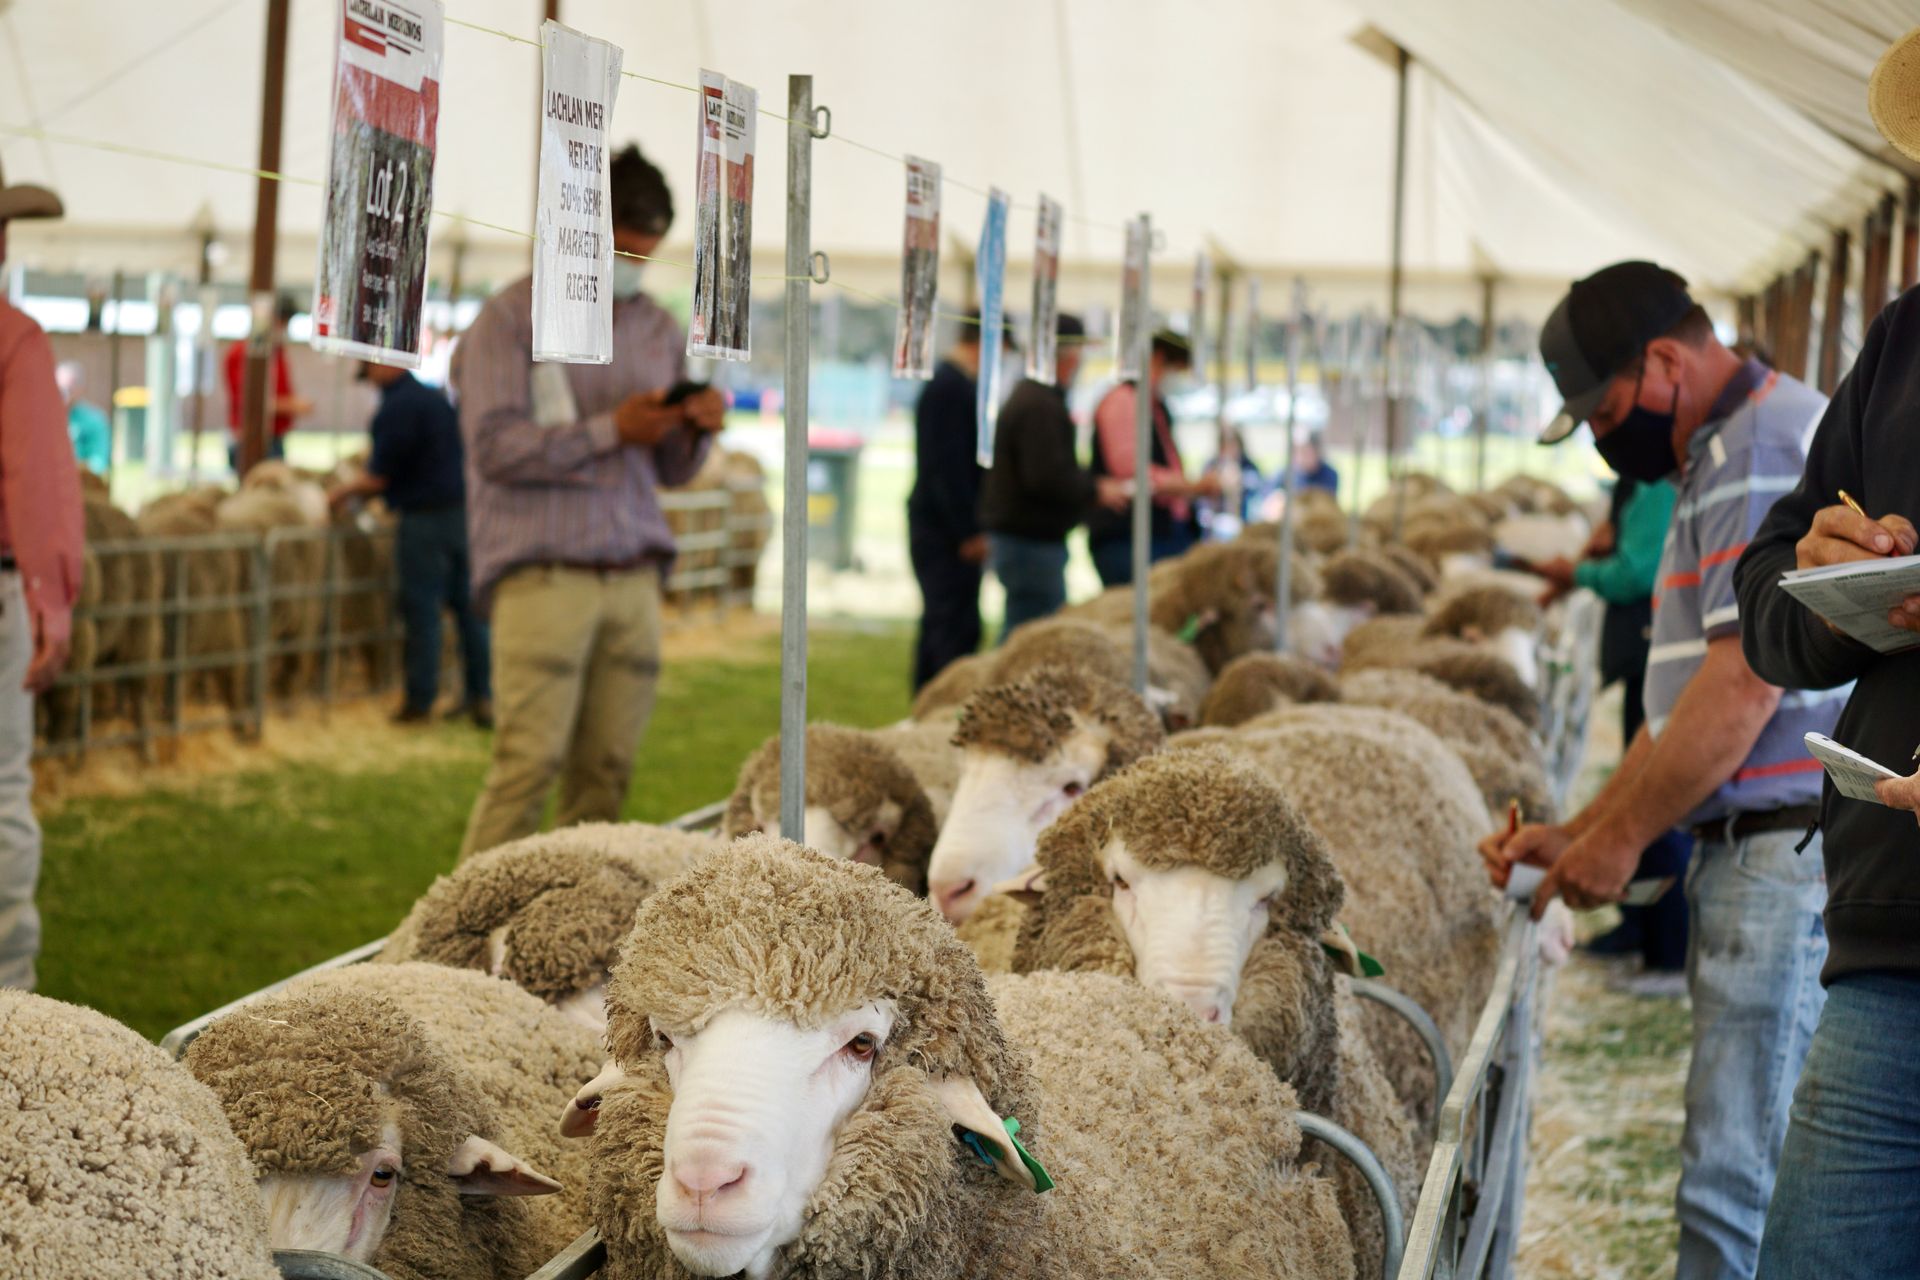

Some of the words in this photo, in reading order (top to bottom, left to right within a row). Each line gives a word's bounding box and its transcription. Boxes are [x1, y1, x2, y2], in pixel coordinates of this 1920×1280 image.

[547, 89, 583, 127] LACHLAN
[366, 151, 394, 219] Lot
[394, 161, 408, 224] 2
[560, 182, 581, 214] 50%
[565, 272, 598, 304] RIGHTS
